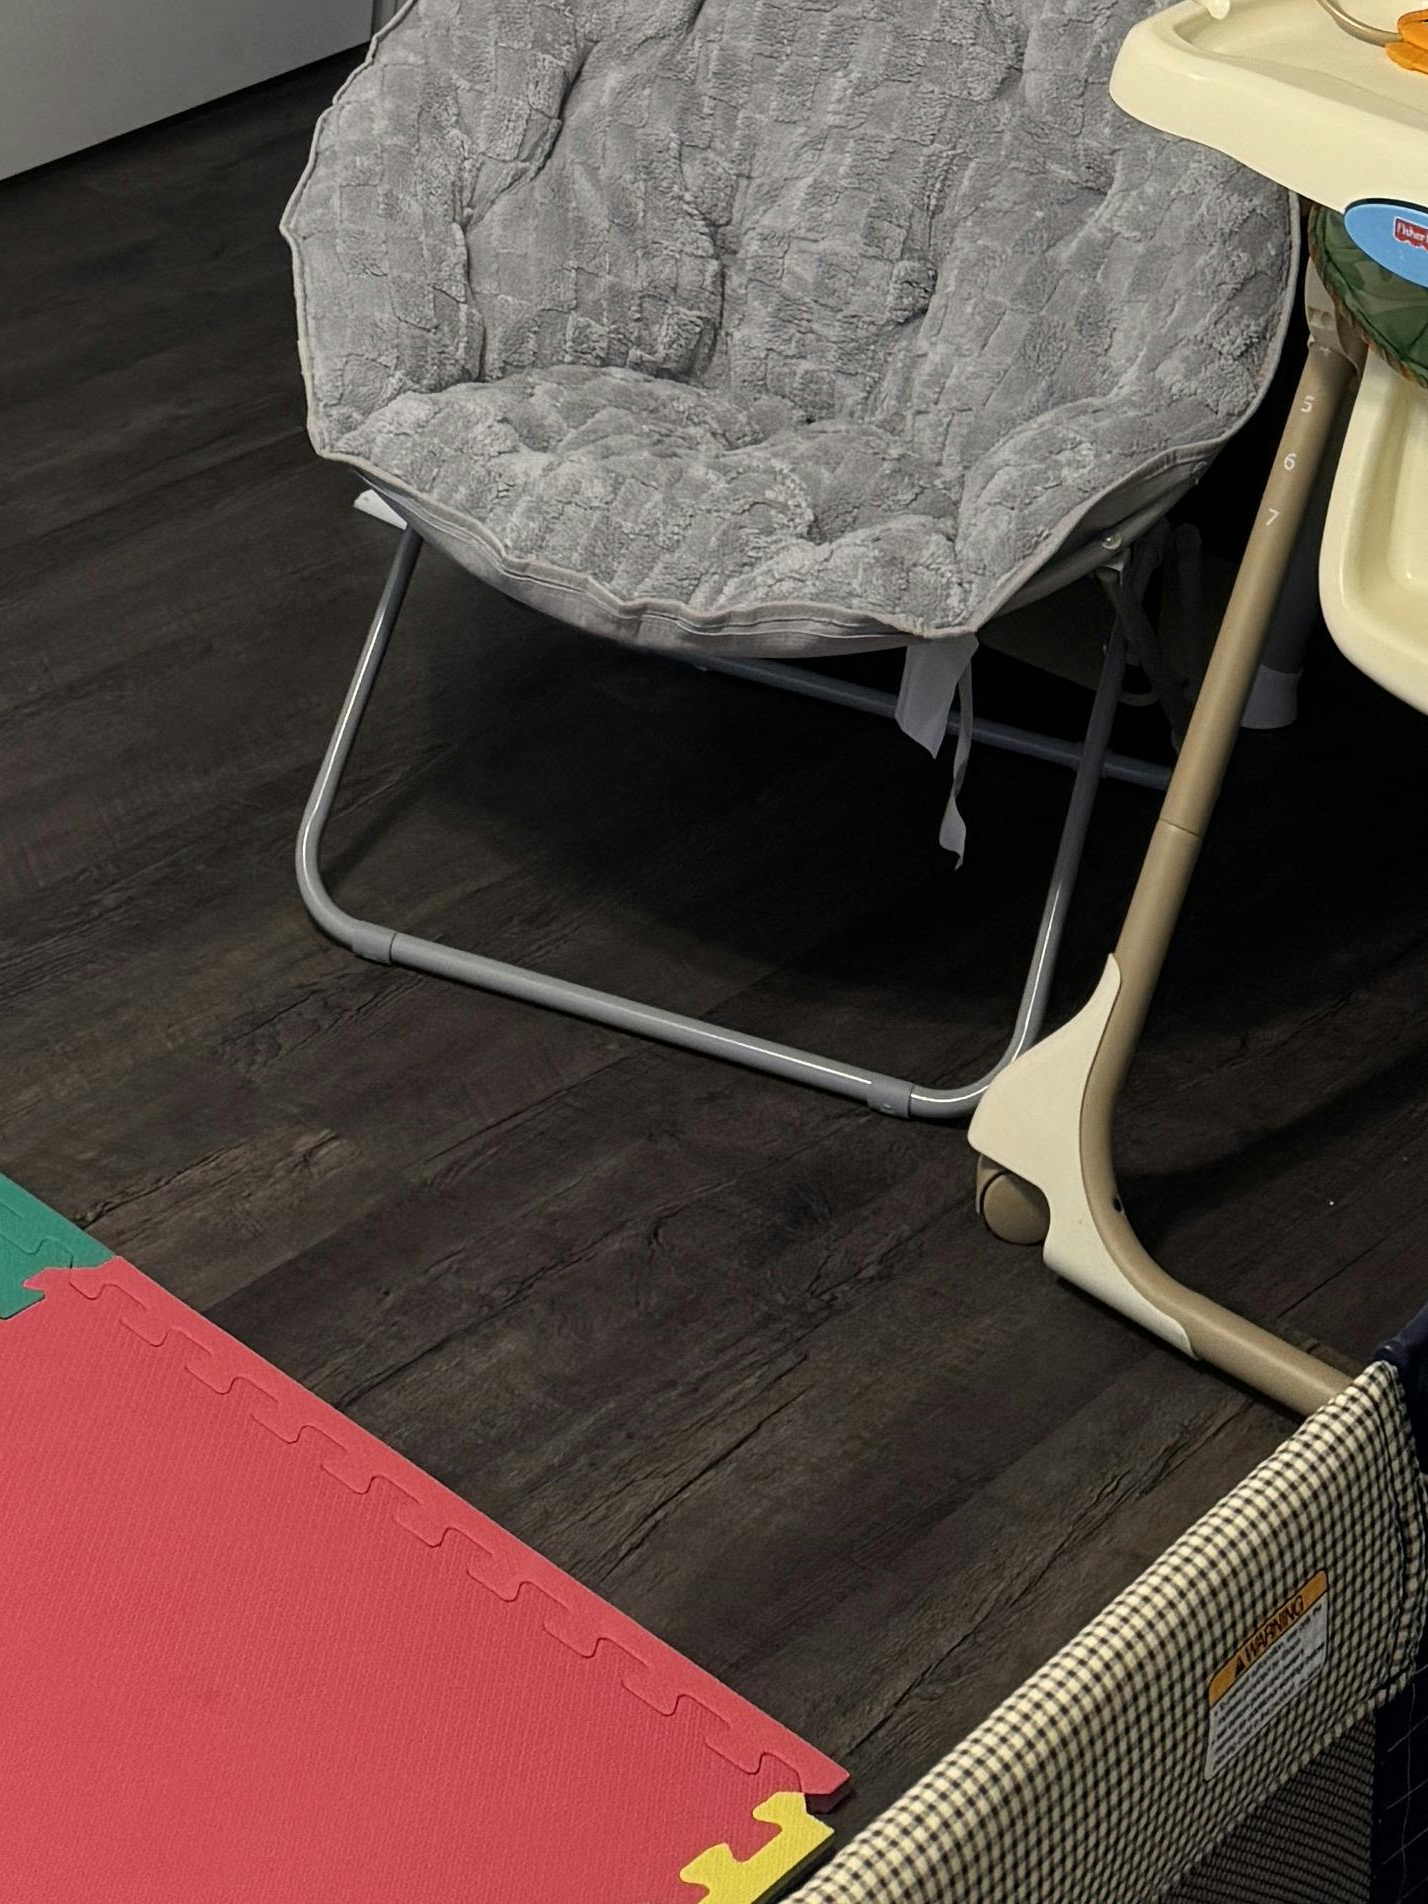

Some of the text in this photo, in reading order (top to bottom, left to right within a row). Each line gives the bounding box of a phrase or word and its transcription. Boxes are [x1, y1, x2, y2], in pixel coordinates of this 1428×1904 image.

[1300, 395, 1315, 414] 5
[1283, 452, 1297, 471] 6
[1266, 507, 1281, 528] 7
